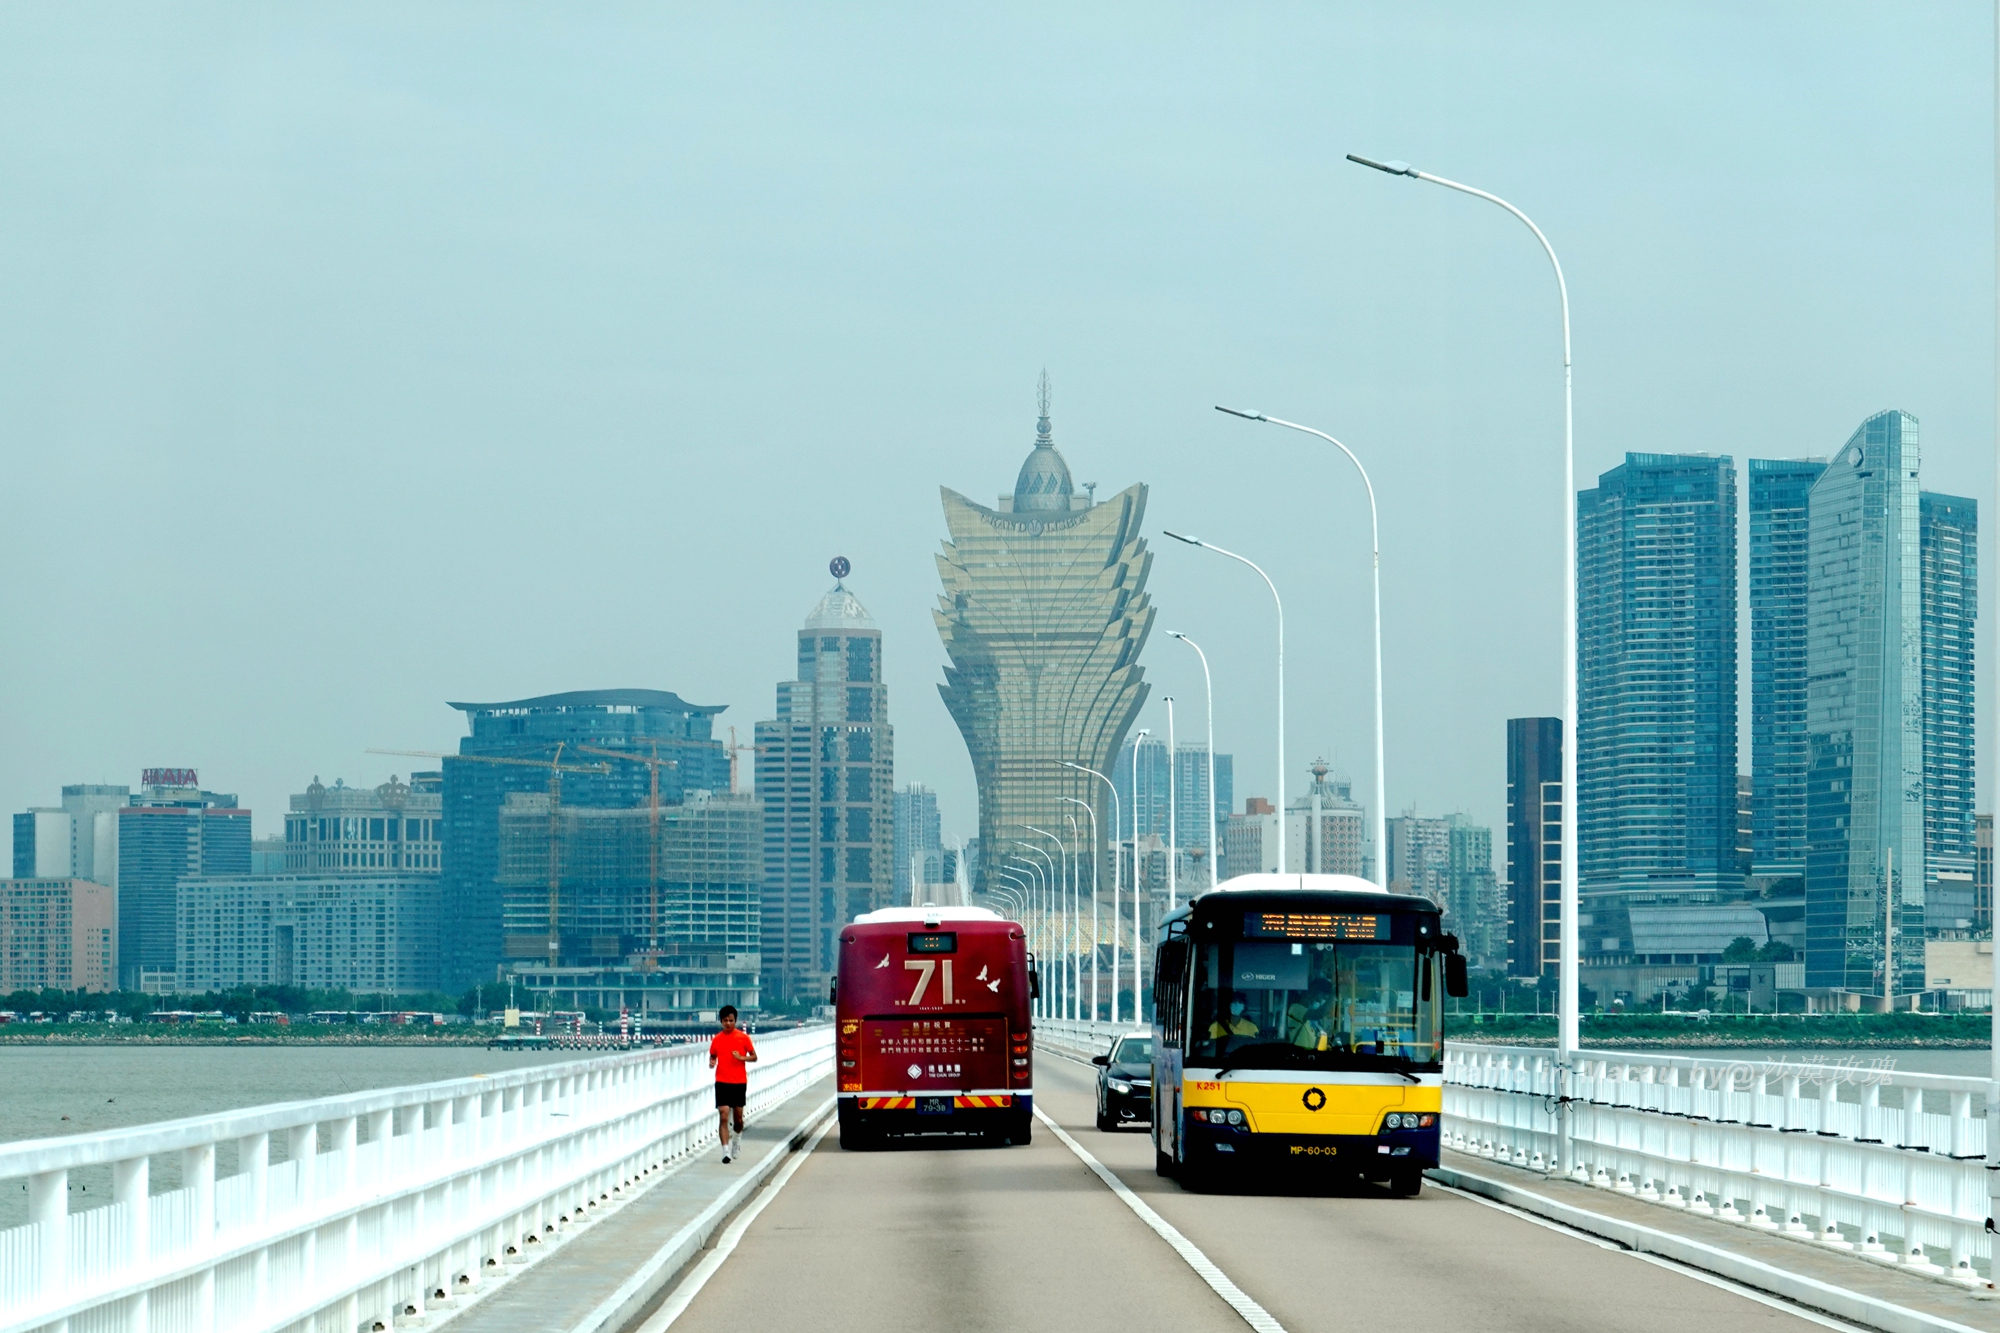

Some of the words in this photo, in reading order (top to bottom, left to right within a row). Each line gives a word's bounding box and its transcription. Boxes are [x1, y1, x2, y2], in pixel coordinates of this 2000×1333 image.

[981, 513, 1027, 533] GRAND
[1046, 513, 1091, 533] LISBOA
[904, 959, 953, 1005] 71
[1197, 1081, 1221, 1091] K251
[1290, 1145, 1337, 1155] MP-60-03
